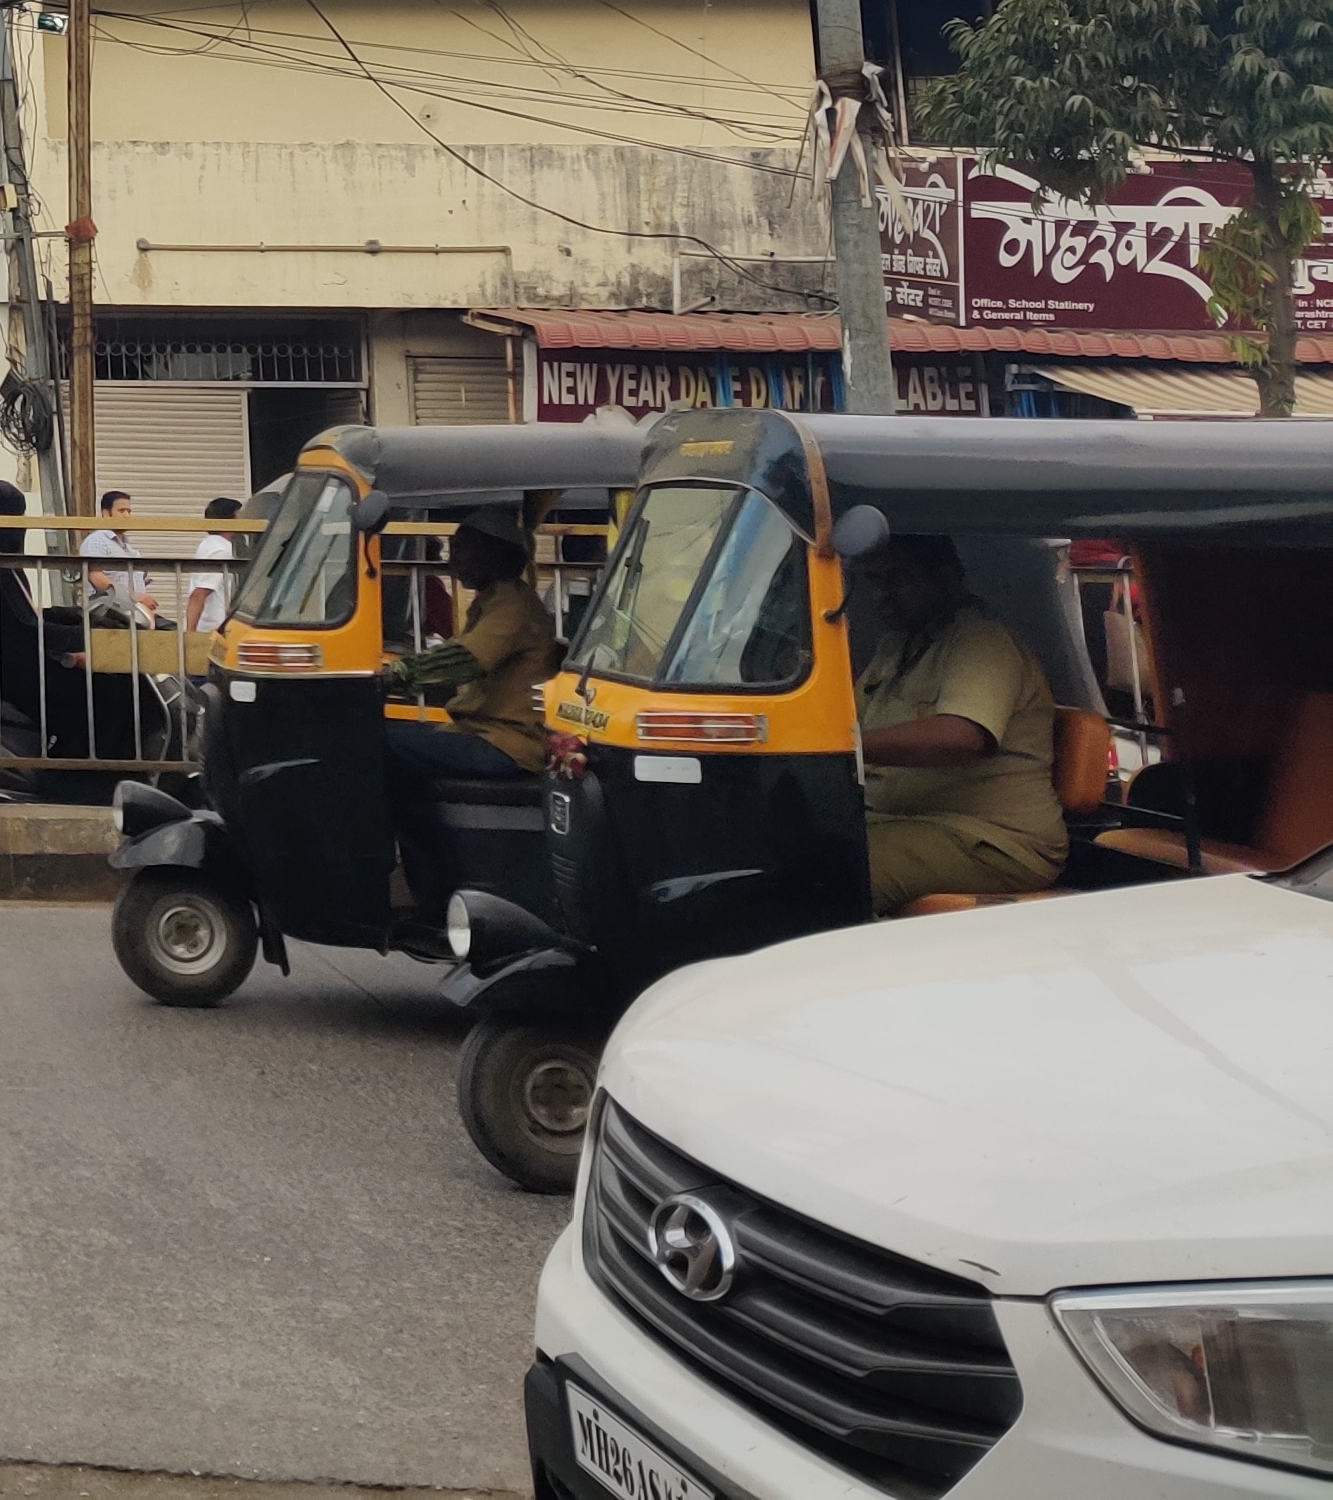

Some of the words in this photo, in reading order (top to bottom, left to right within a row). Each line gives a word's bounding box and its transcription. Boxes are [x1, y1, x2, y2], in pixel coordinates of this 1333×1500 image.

[972, 299, 1007, 309] Office,
[1008, 299, 1045, 309] School
[1047, 300, 1094, 312] Statinery
[983, 310, 1024, 320] General
[1026, 311, 1055, 320] Items
[543, 361, 598, 405] NEW
[606, 363, 671, 408] YEAR
